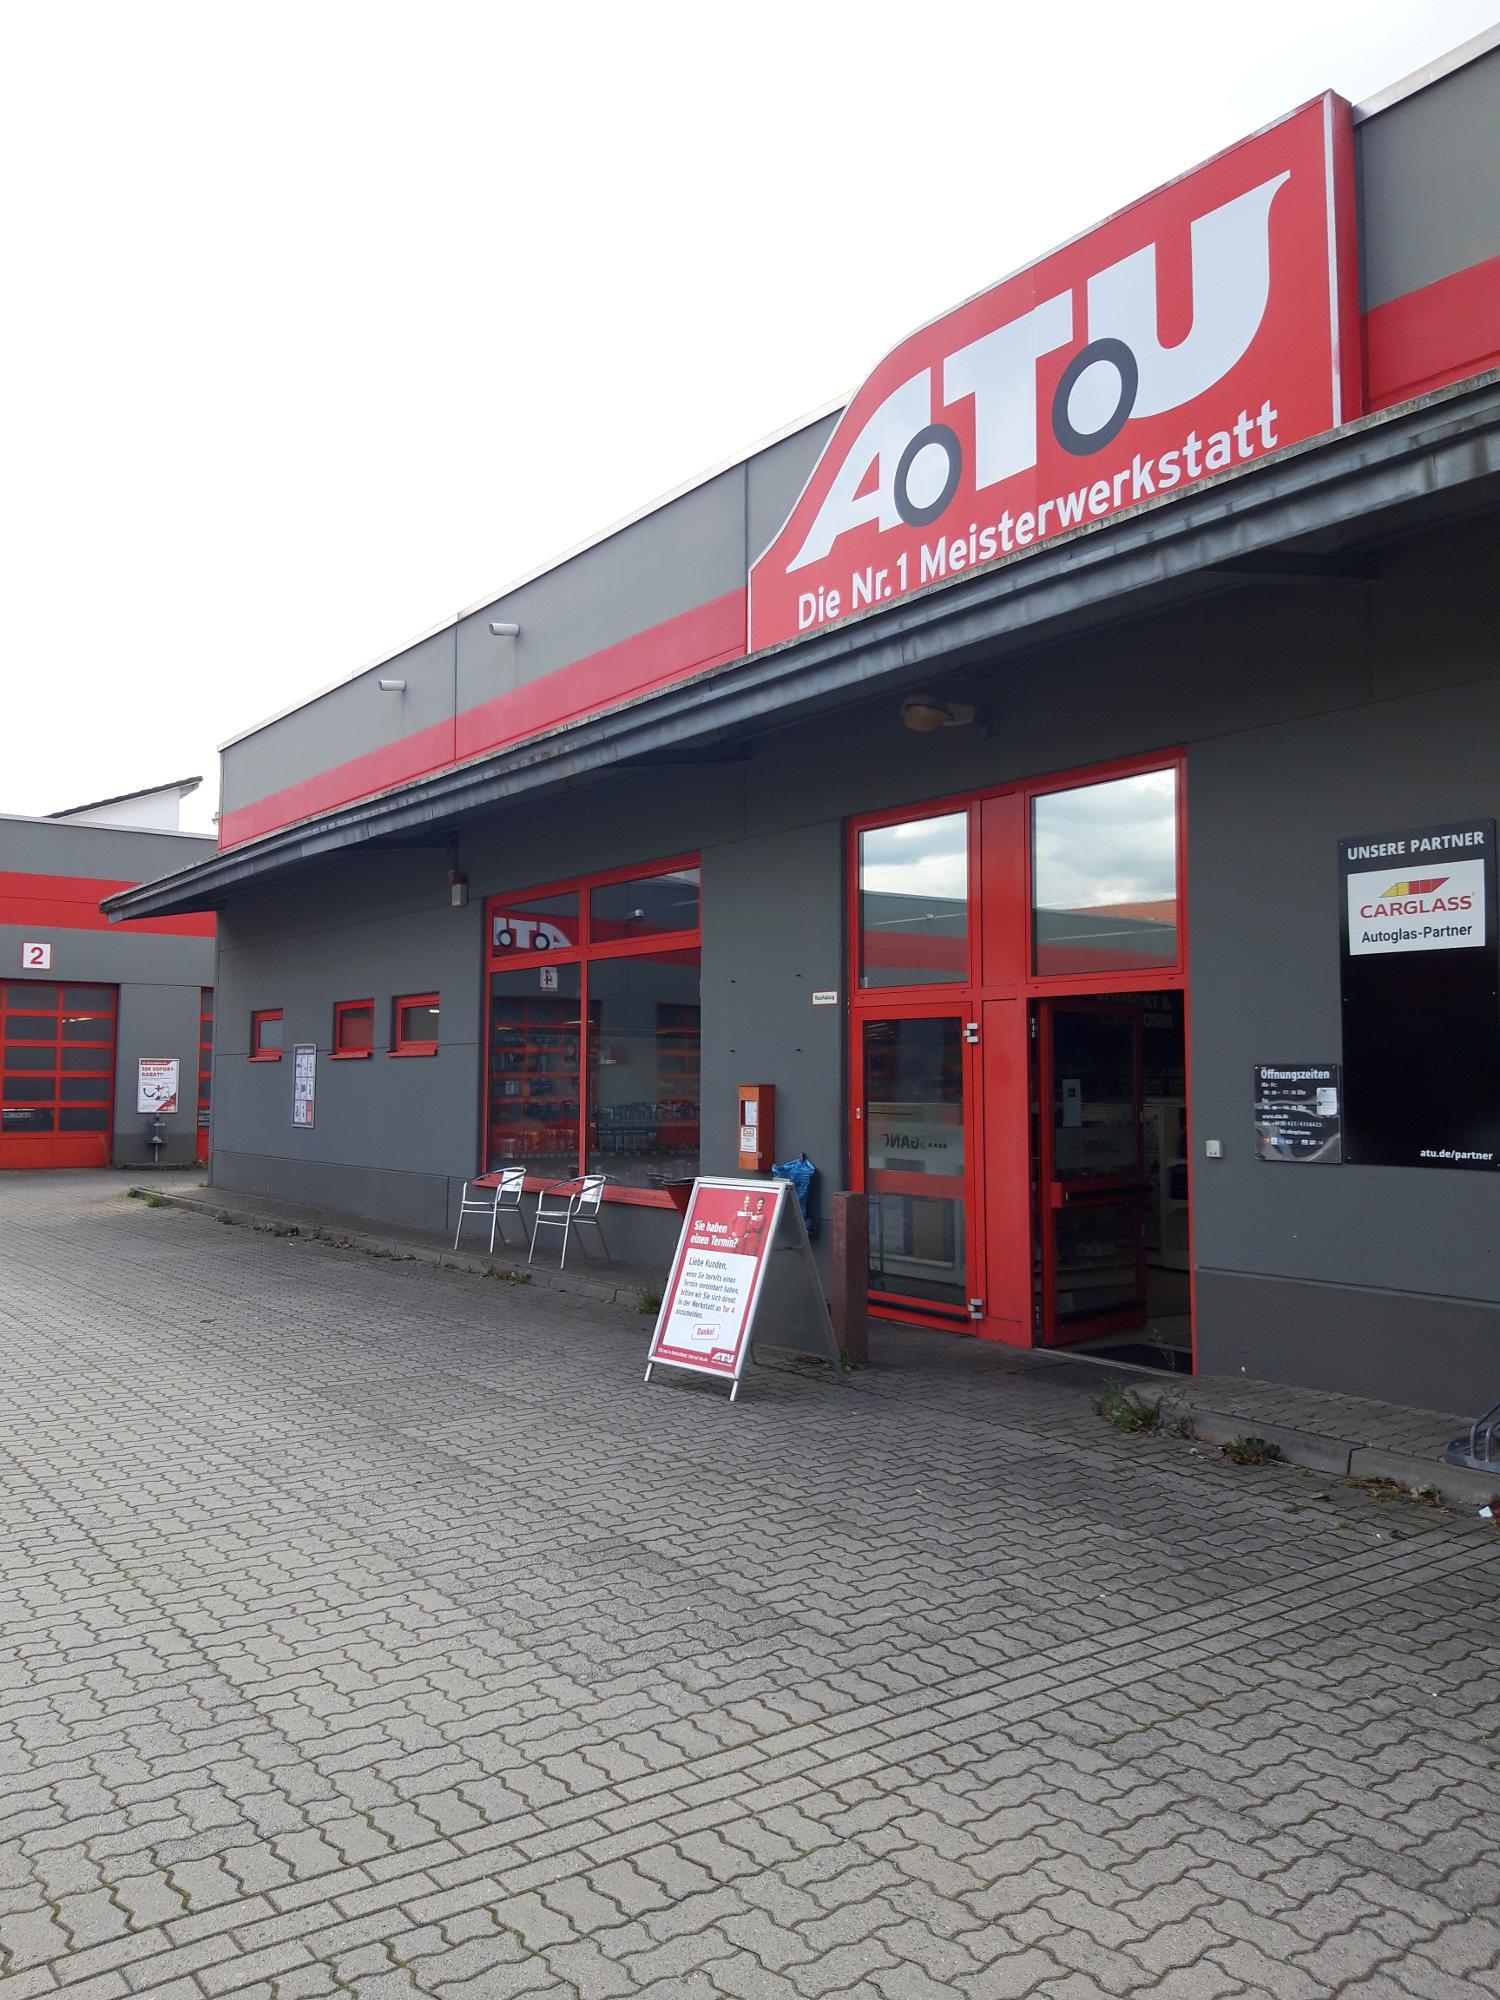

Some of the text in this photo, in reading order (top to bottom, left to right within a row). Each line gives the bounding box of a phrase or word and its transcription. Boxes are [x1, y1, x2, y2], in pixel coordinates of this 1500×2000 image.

[798, 585, 841, 630] Die
[921, 399, 1279, 583] Meisterwerkstatt
[1347, 831, 1485, 860] UNSERE PARTNER
[1360, 895, 1473, 919] CARGLASS
[1361, 925, 1473, 944] Autoglas-Partner
[31, 946, 44, 965] 2
[1260, 1066, 1330, 1081] Öffnungszeiten
[1420, 1148, 1494, 1161] atu.de/partner
[694, 1220, 728, 1233] Sie haben
[690, 1233, 739, 1248] einen Termin?
[688, 1256, 728, 1271] Liebe Kunden,
[683, 1279, 698, 1288] Termin
[698, 1282, 723, 1292] vereinbart
[705, 1272, 722, 1281] bereits
[722, 1275, 736, 1284] einen
[680, 1288, 695, 1297] bitten
[703, 1291, 711, 1300] Sie
[711, 1293, 722, 1302] sich
[722, 1294, 737, 1304] direkt
[691, 1301, 715, 1311] Werkstatt
[722, 1305, 731, 1313] Tor
[696, 1327, 716, 1336] Danke!
